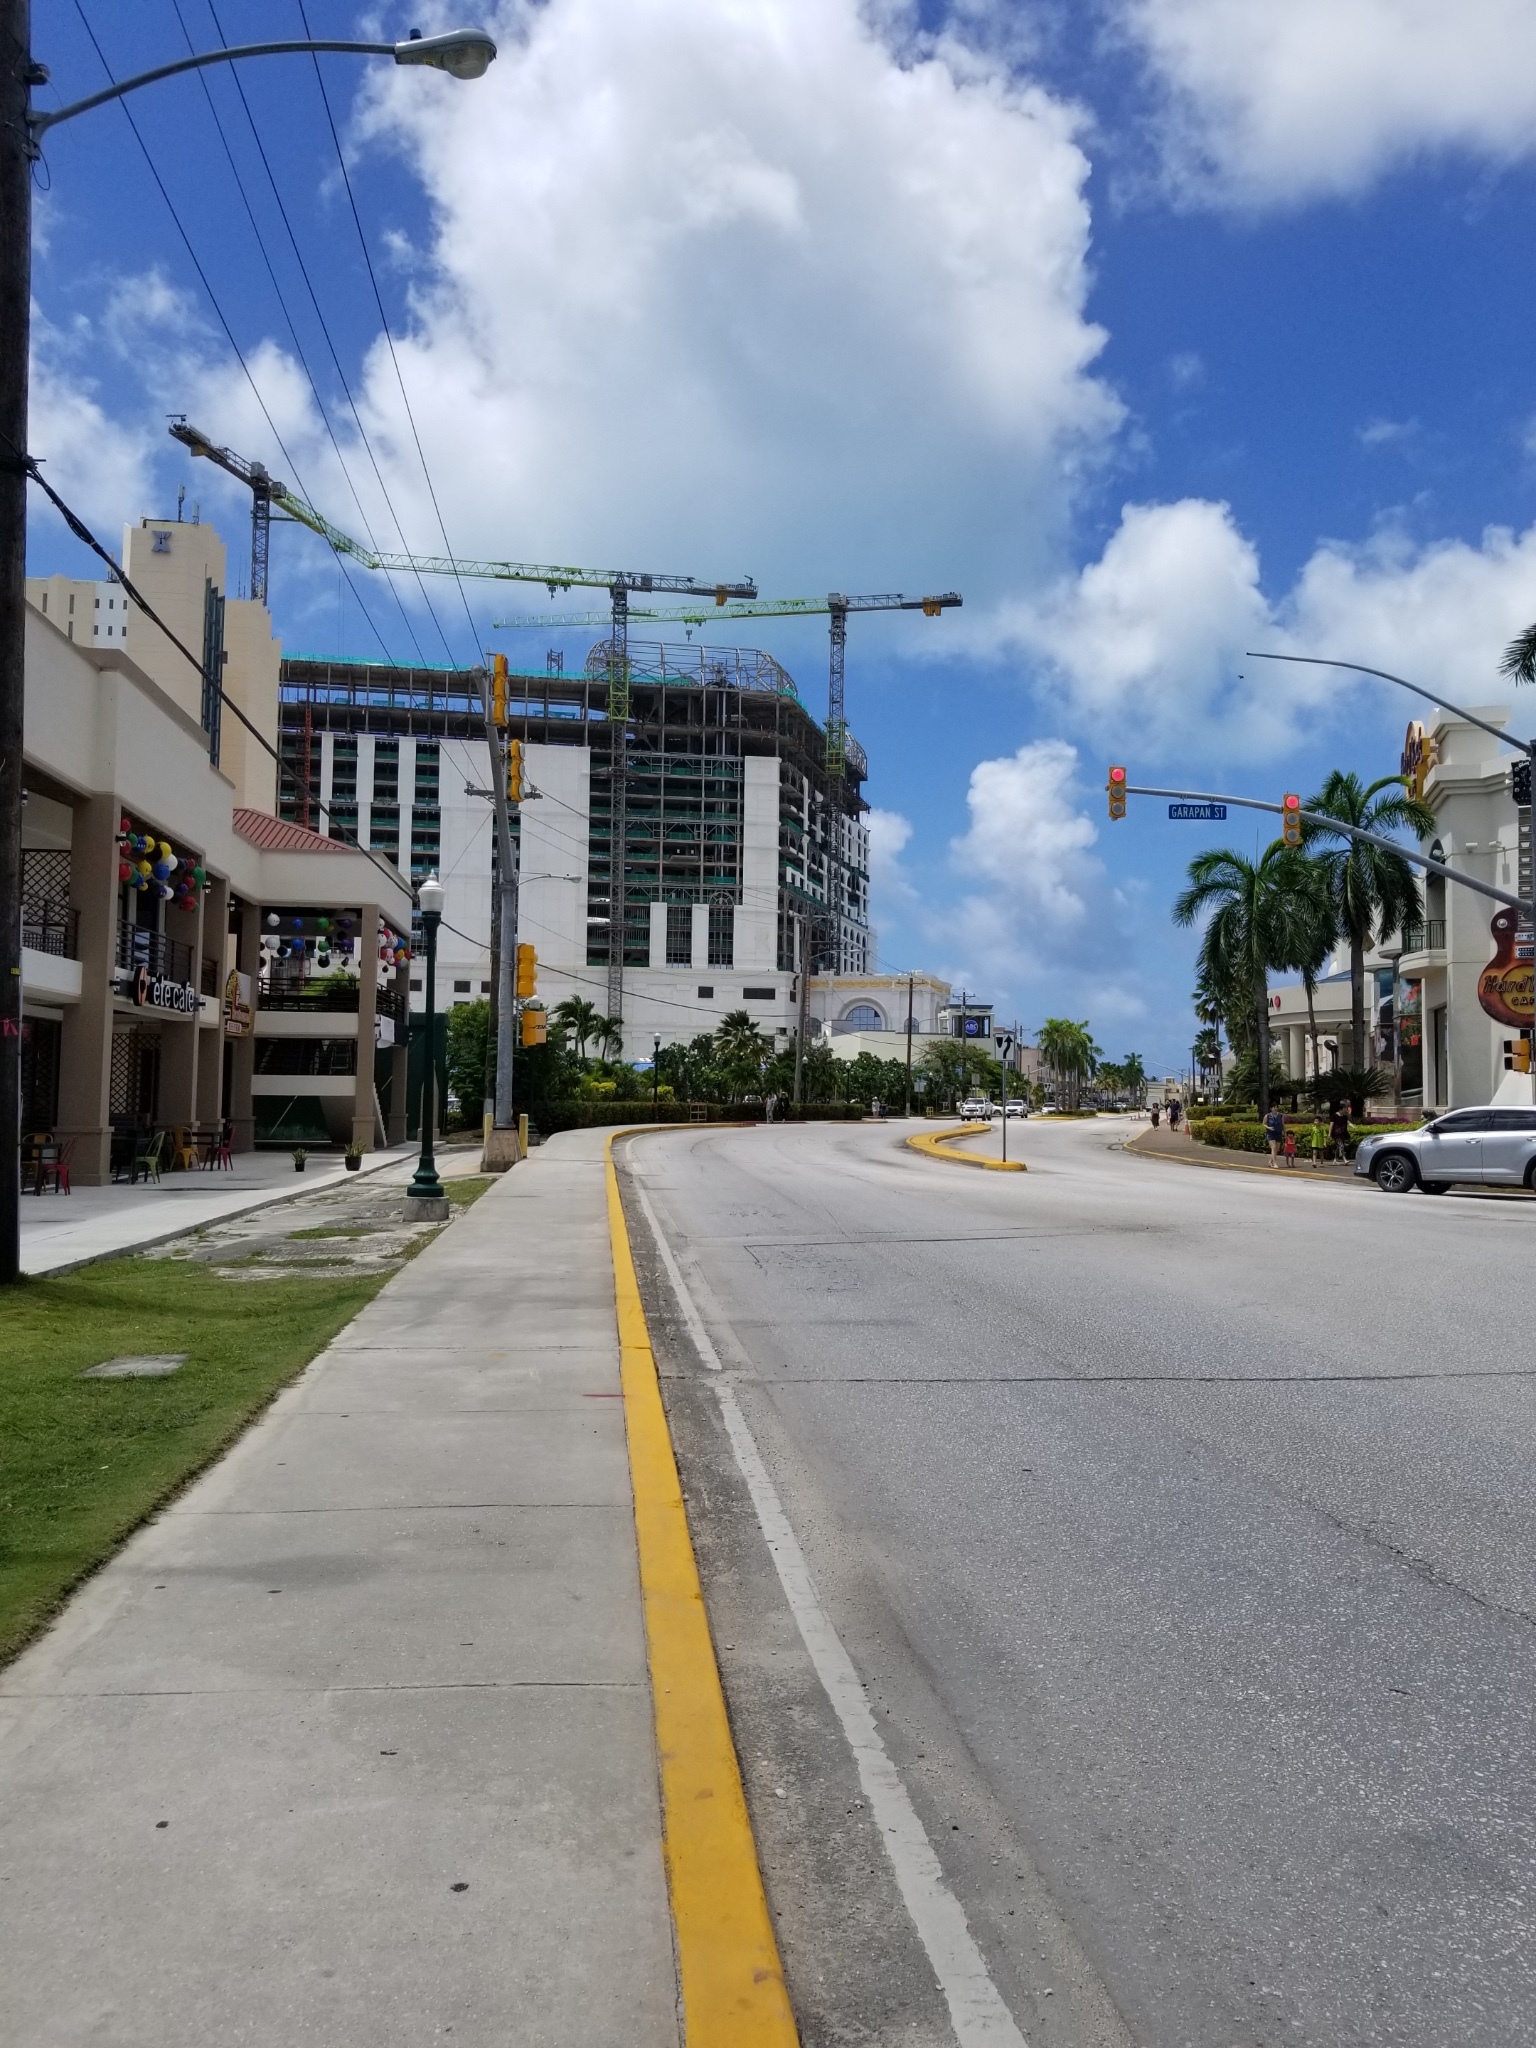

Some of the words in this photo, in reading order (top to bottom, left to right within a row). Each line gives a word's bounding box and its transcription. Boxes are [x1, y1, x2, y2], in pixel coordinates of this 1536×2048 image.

[1171, 806, 1211, 818] GARAPAN
[1214, 807, 1224, 818] ST
[1483, 975, 1528, 993] Hard
